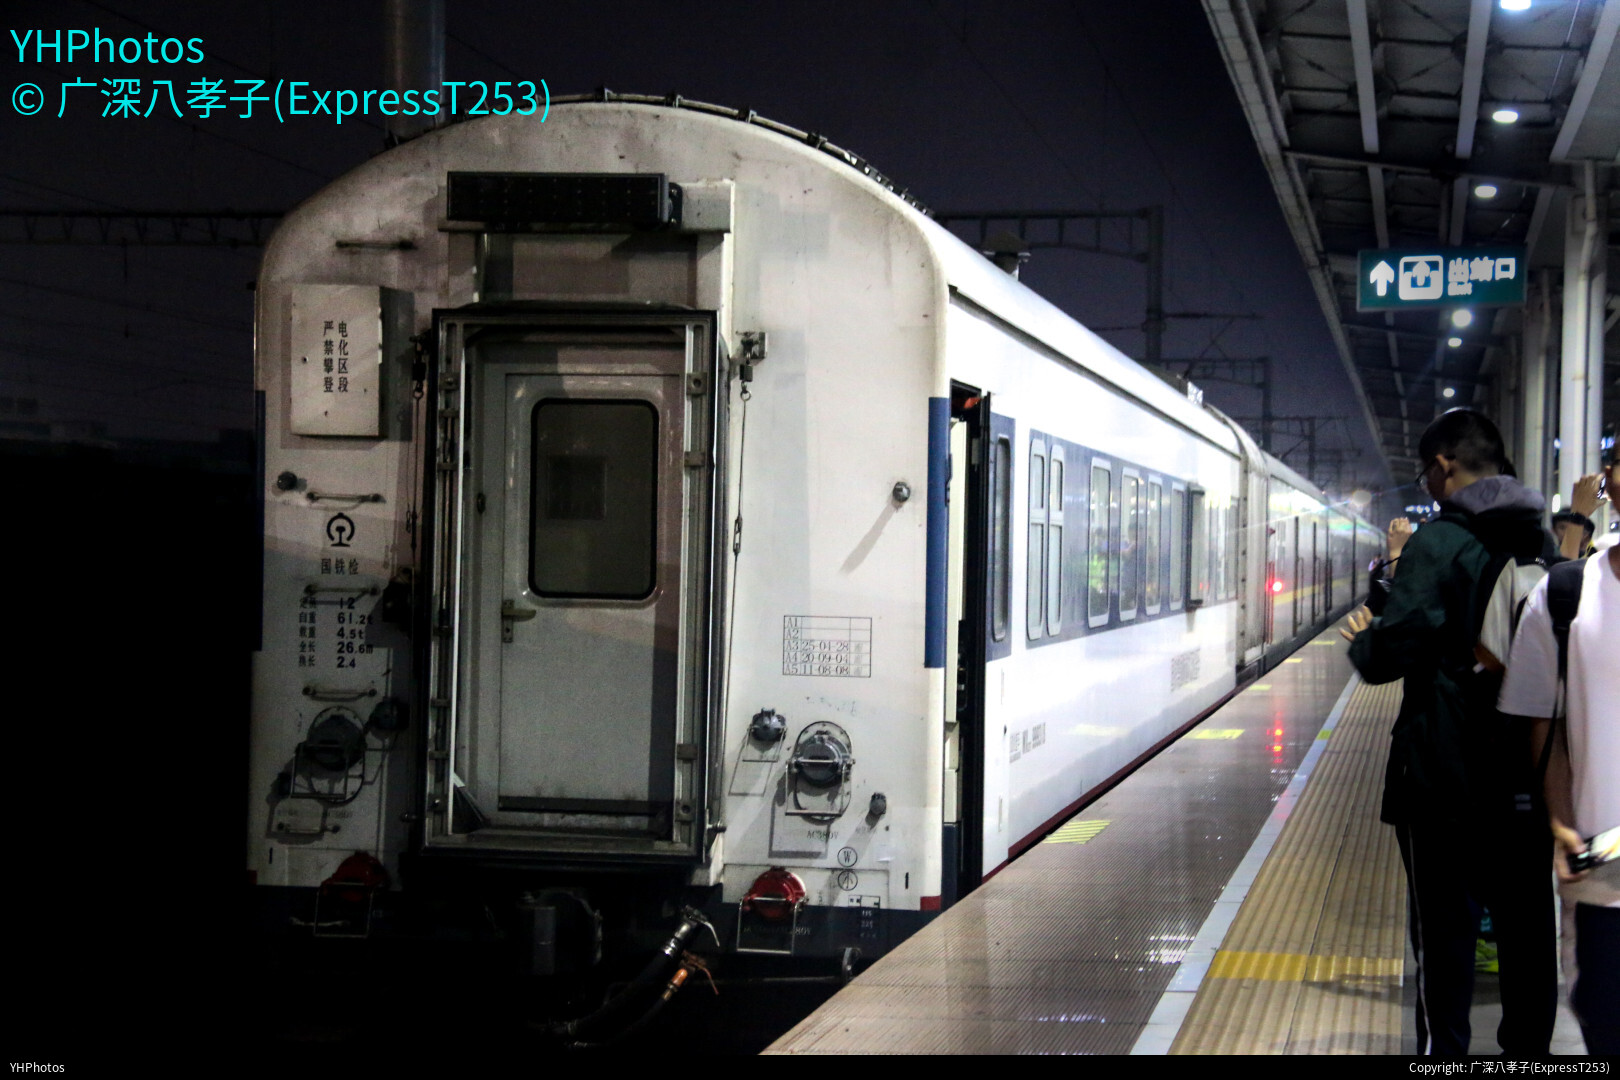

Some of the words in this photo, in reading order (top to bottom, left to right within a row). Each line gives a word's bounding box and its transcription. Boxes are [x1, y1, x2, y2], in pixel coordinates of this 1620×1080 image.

[323, 320, 334, 393] 严禁攀登
[338, 320, 348, 393] 电化区段
[337, 627, 364, 640] 4.5t
[337, 642, 373, 654] 26.6m
[337, 656, 356, 668] 2.4
